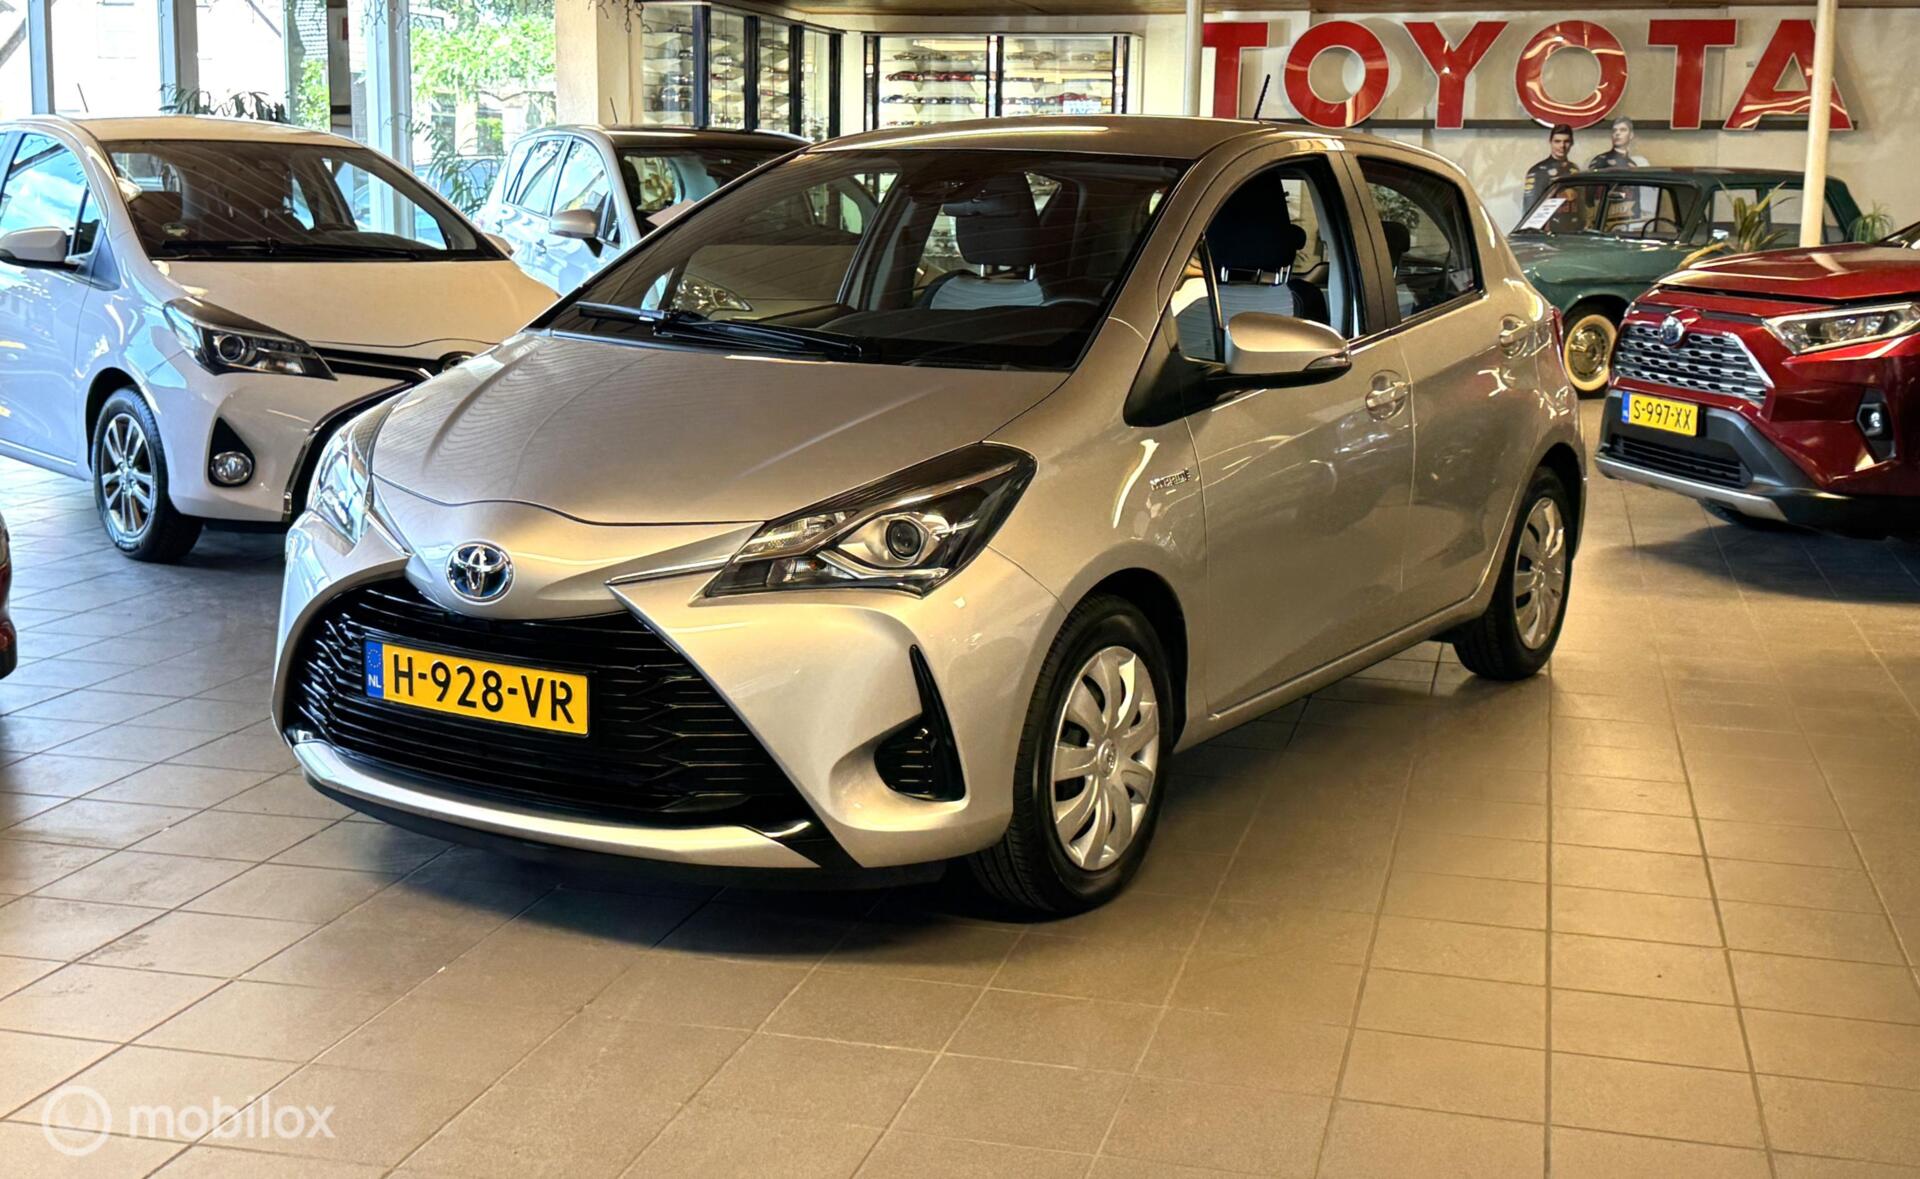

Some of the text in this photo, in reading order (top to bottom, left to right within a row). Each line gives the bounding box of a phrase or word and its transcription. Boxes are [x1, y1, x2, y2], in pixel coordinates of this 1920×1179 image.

[1203, 19, 1853, 131] TOYOTA
[1633, 399, 1692, 431] S-997-XX
[368, 673, 382, 689] NL
[393, 653, 575, 724] H-928-VR
